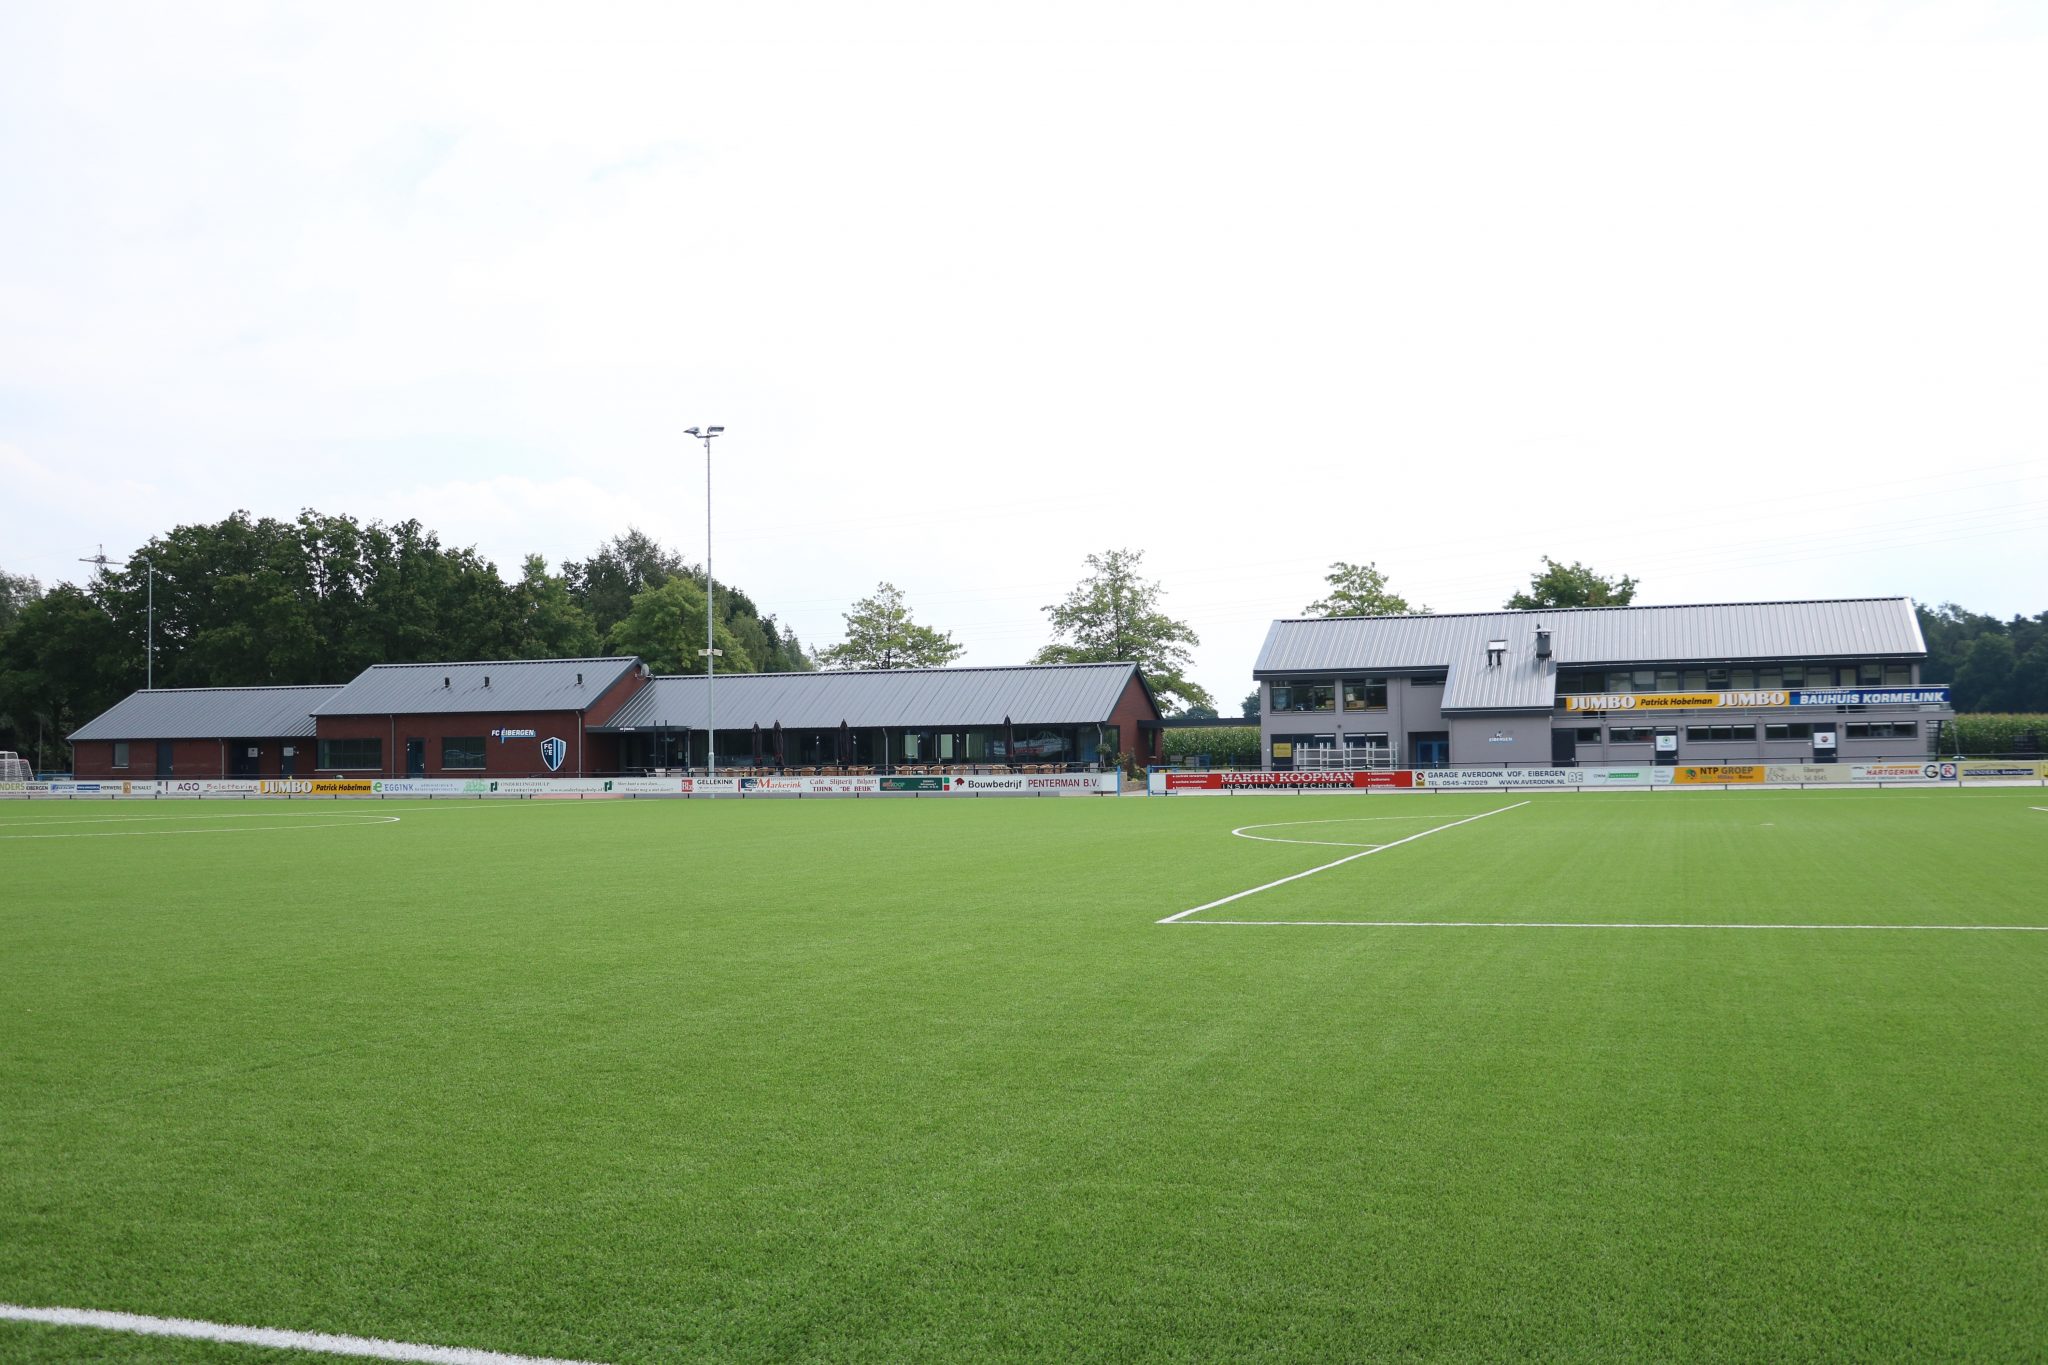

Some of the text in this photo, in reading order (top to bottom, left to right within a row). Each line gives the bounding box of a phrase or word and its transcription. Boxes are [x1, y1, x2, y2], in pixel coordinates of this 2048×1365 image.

[1570, 696, 1636, 710] JUMBO
[1670, 697, 1713, 705] Hobelman
[1717, 691, 1785, 707] JUMBO
[1800, 692, 1945, 705] BAUHUIS KORMELINK
[1700, 767, 1754, 775] NTP GROEP
[1221, 772, 1354, 782] MARTIN KOOPMAN
[177, 782, 200, 791] AGO
[263, 780, 371, 794] JUMBO Patrick Hobelman
[384, 783, 414, 791] EGGINK
[757, 778, 802, 789] Markerink
[968, 778, 1100, 789] Bouwbedrijf PENTERMAN B.V.
